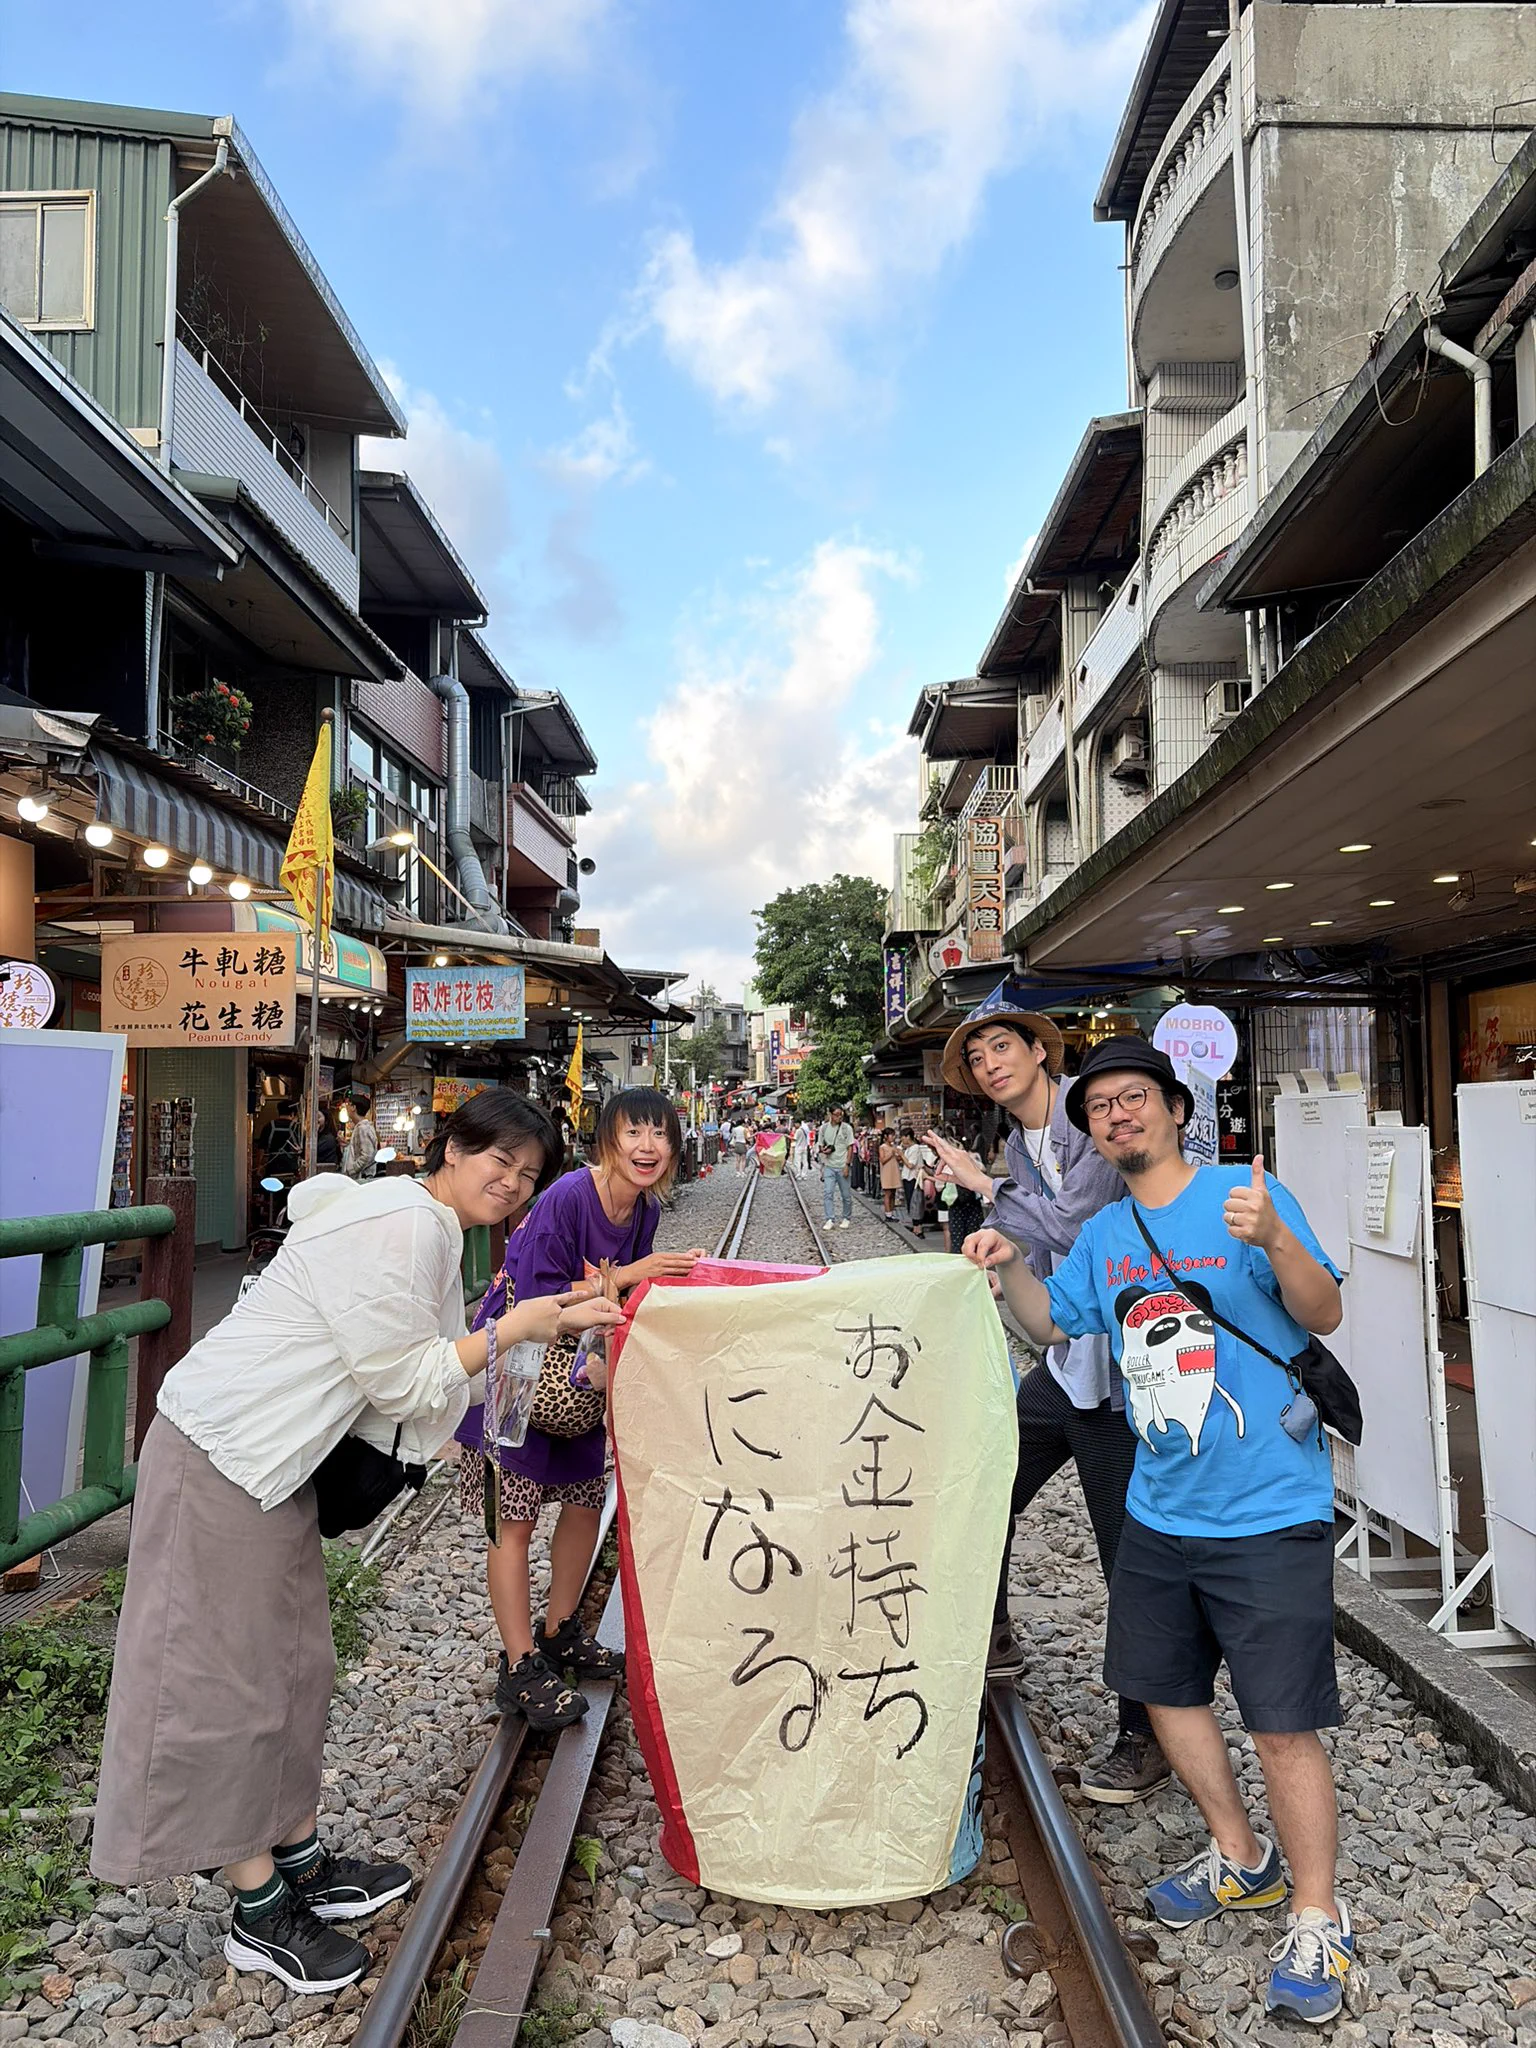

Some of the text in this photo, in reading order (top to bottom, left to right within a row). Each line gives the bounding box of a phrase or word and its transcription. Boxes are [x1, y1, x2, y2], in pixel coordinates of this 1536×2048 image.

[971, 820, 1001, 933] 協豐天燈
[178, 946, 287, 978] 牛軋糖
[195, 977, 269, 990] Nougat
[412, 980, 494, 1013] 酥炸花枝
[178, 1000, 285, 1032] 花生糖
[1165, 1017, 1226, 1032] MOBRO
[188, 1031, 273, 1042] Peanut Candy
[1164, 1039, 1225, 1060] IDOL
[437, 1082, 471, 1094] 花枝丸
[1126, 1353, 1152, 1369] BOILER
[827, 1312, 930, 1760] お金持ち
[701, 1384, 826, 1754] になる
[1216, 1874, 1247, 1907] N
